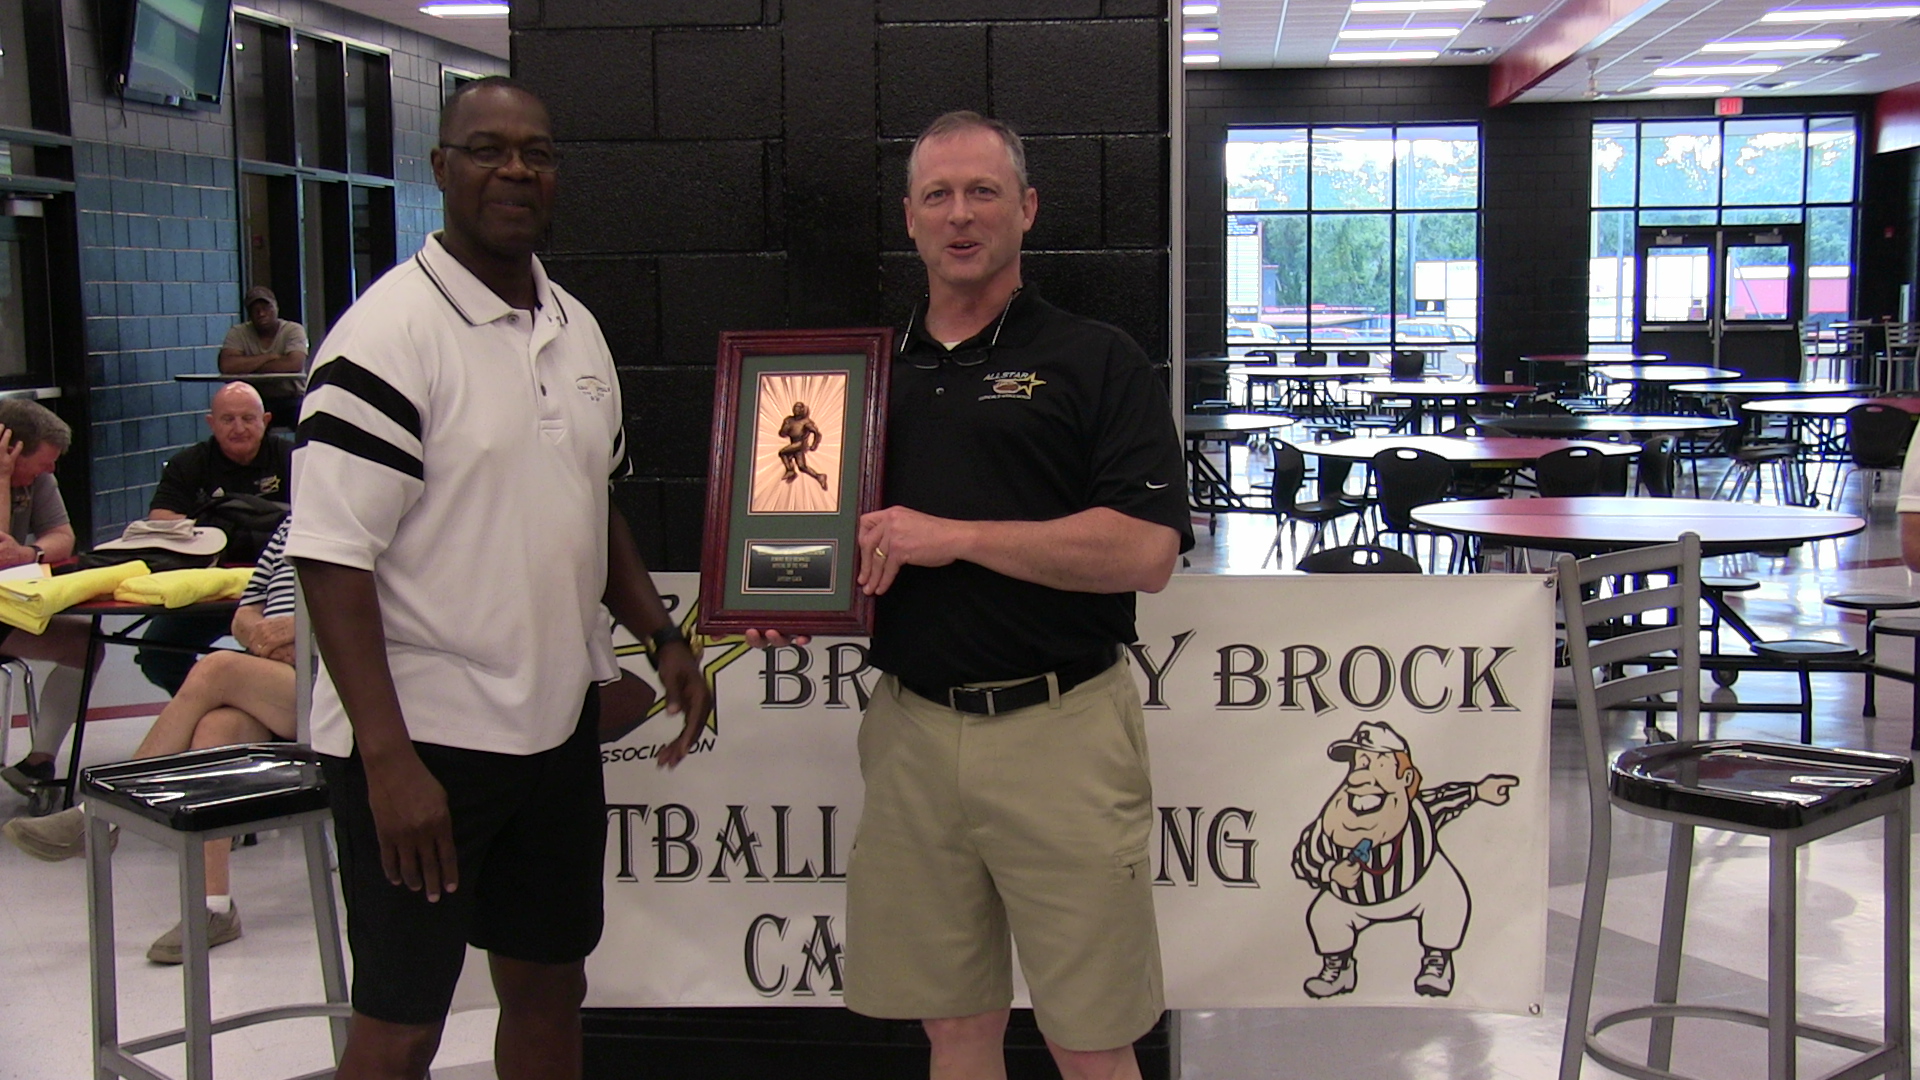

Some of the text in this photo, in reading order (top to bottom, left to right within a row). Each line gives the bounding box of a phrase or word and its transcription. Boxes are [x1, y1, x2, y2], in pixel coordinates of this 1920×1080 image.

[758, 628, 1521, 716] BR Y BROCK
[601, 738, 716, 764] SSOCION
[605, 803, 1261, 889] TBALL NG
[744, 913, 845, 998] CA
